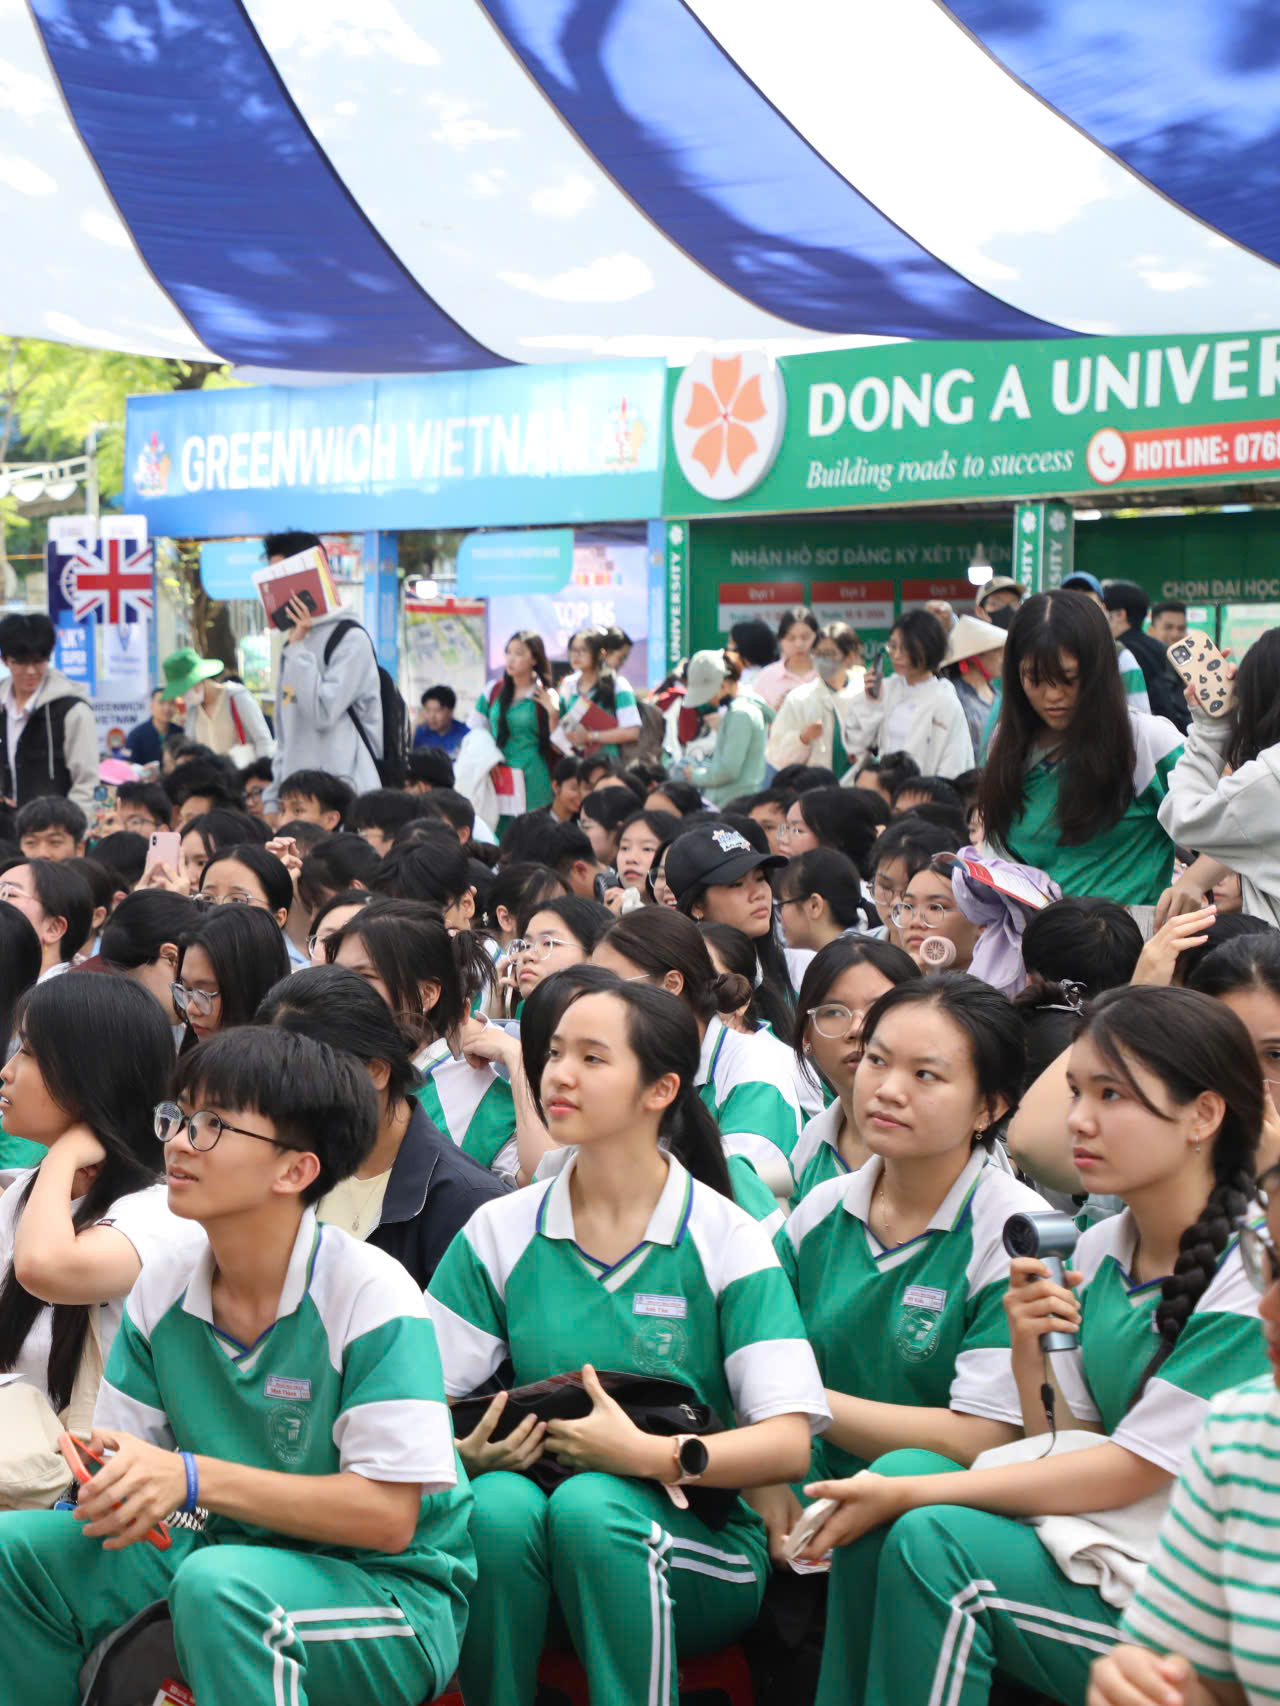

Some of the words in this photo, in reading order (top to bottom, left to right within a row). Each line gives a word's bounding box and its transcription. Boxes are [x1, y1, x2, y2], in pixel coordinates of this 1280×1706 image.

[808, 368, 975, 438] DONG
[990, 363, 1031, 423] A
[181, 422, 397, 493] GREENWICH
[406, 407, 590, 480] VIETNAM
[1132, 434, 1229, 473] HOTLINE:
[806, 458, 892, 493] Building
[897, 451, 956, 483] roads
[962, 454, 984, 480] to
[990, 448, 1074, 477] success
[731, 545, 783, 571] NHẬN
[1161, 580, 1209, 602] CHỌN
[554, 601, 590, 626] TOP
